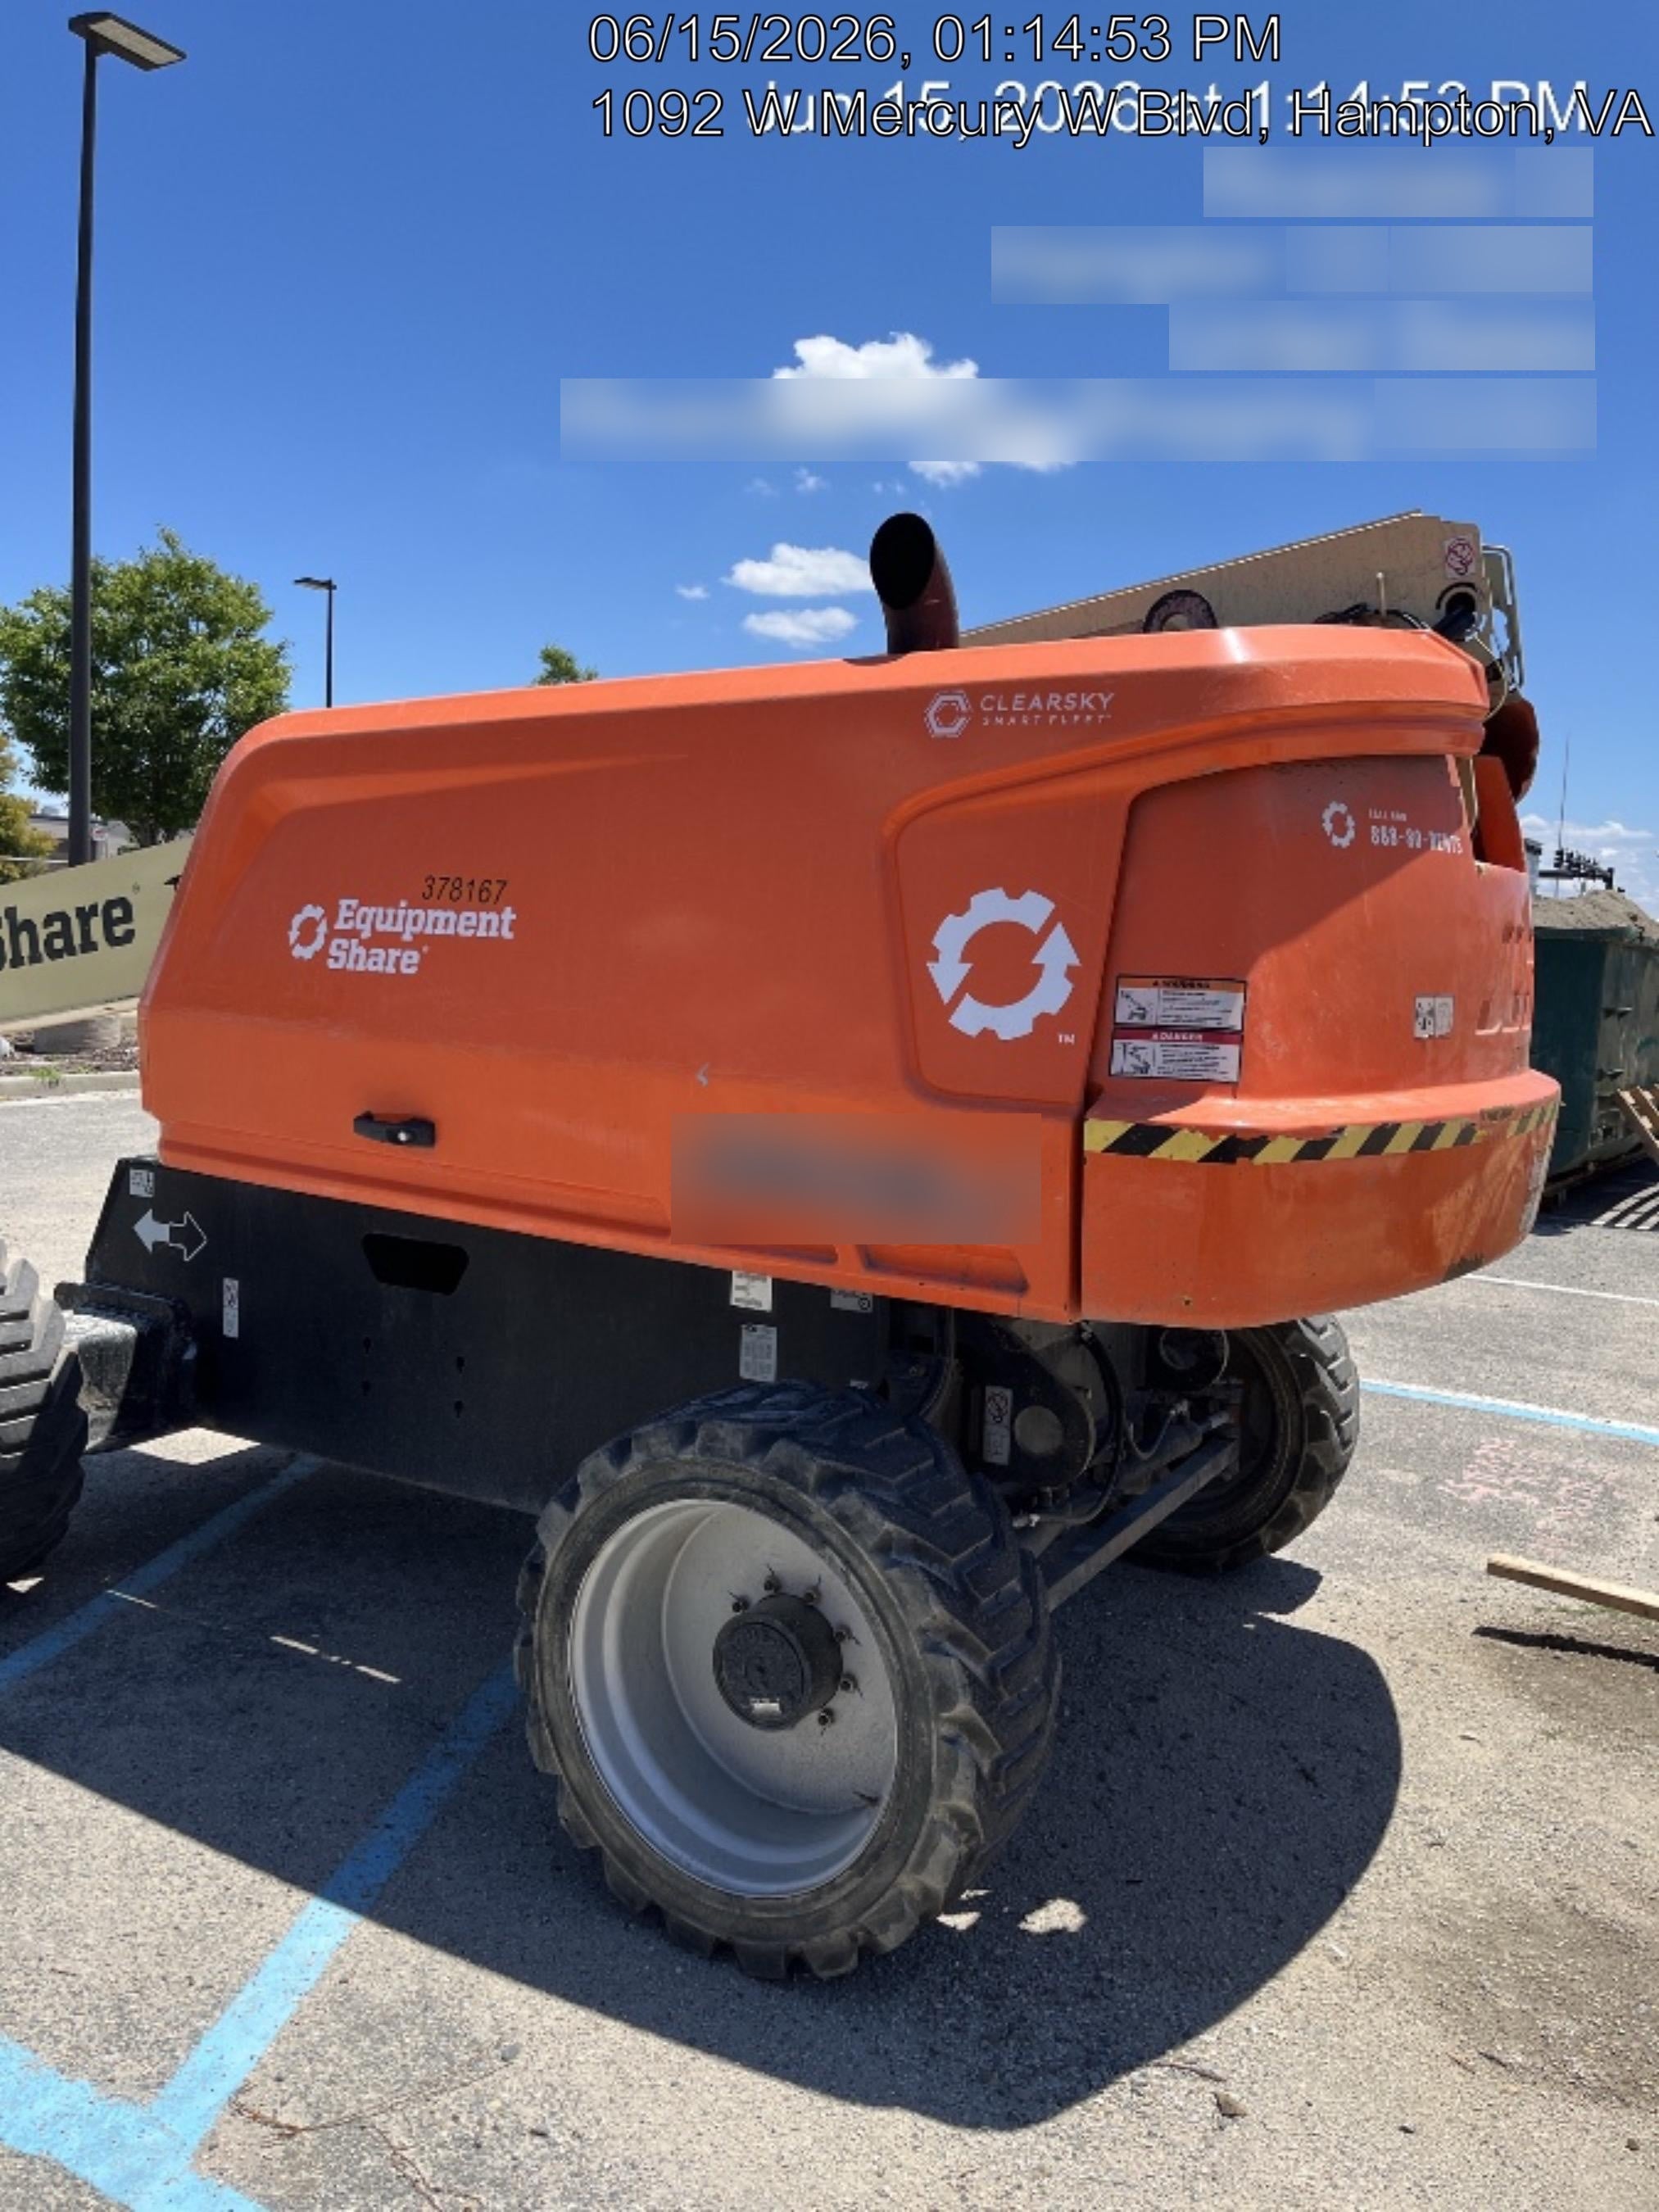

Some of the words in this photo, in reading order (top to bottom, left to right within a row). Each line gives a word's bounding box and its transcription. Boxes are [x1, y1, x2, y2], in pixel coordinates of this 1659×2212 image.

[980, 692, 1115, 713] CLEARSKY
[421, 874, 508, 905] 378167
[333, 899, 518, 941] Equipment
[328, 938, 420, 974] Share
